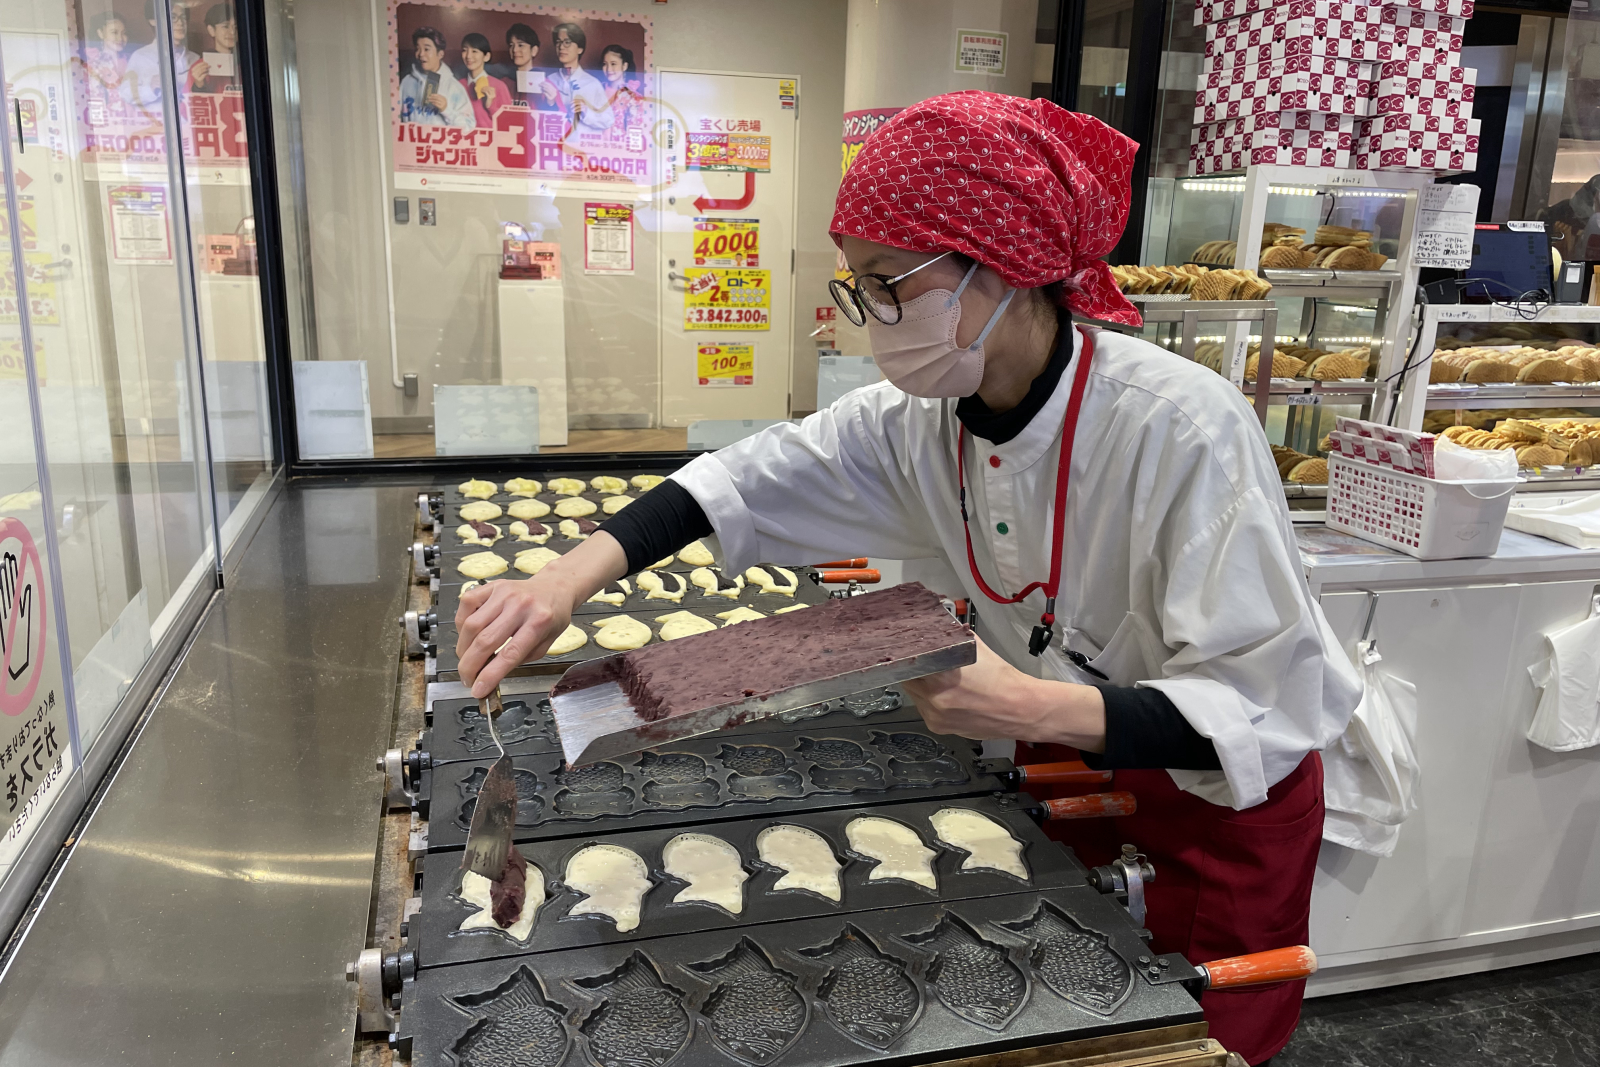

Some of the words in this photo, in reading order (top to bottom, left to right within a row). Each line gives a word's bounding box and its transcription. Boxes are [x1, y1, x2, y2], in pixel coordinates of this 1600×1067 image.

[398, 124, 493, 147] バレンタイン
[700, 118, 761, 132] 宝くじ売場
[416, 145, 478, 166] ジャンボ
[694, 231, 758, 257] 4,000
[688, 272, 717, 294] 大当り
[696, 309, 768, 324] 3,842,300円
[711, 355, 738, 371] 100
